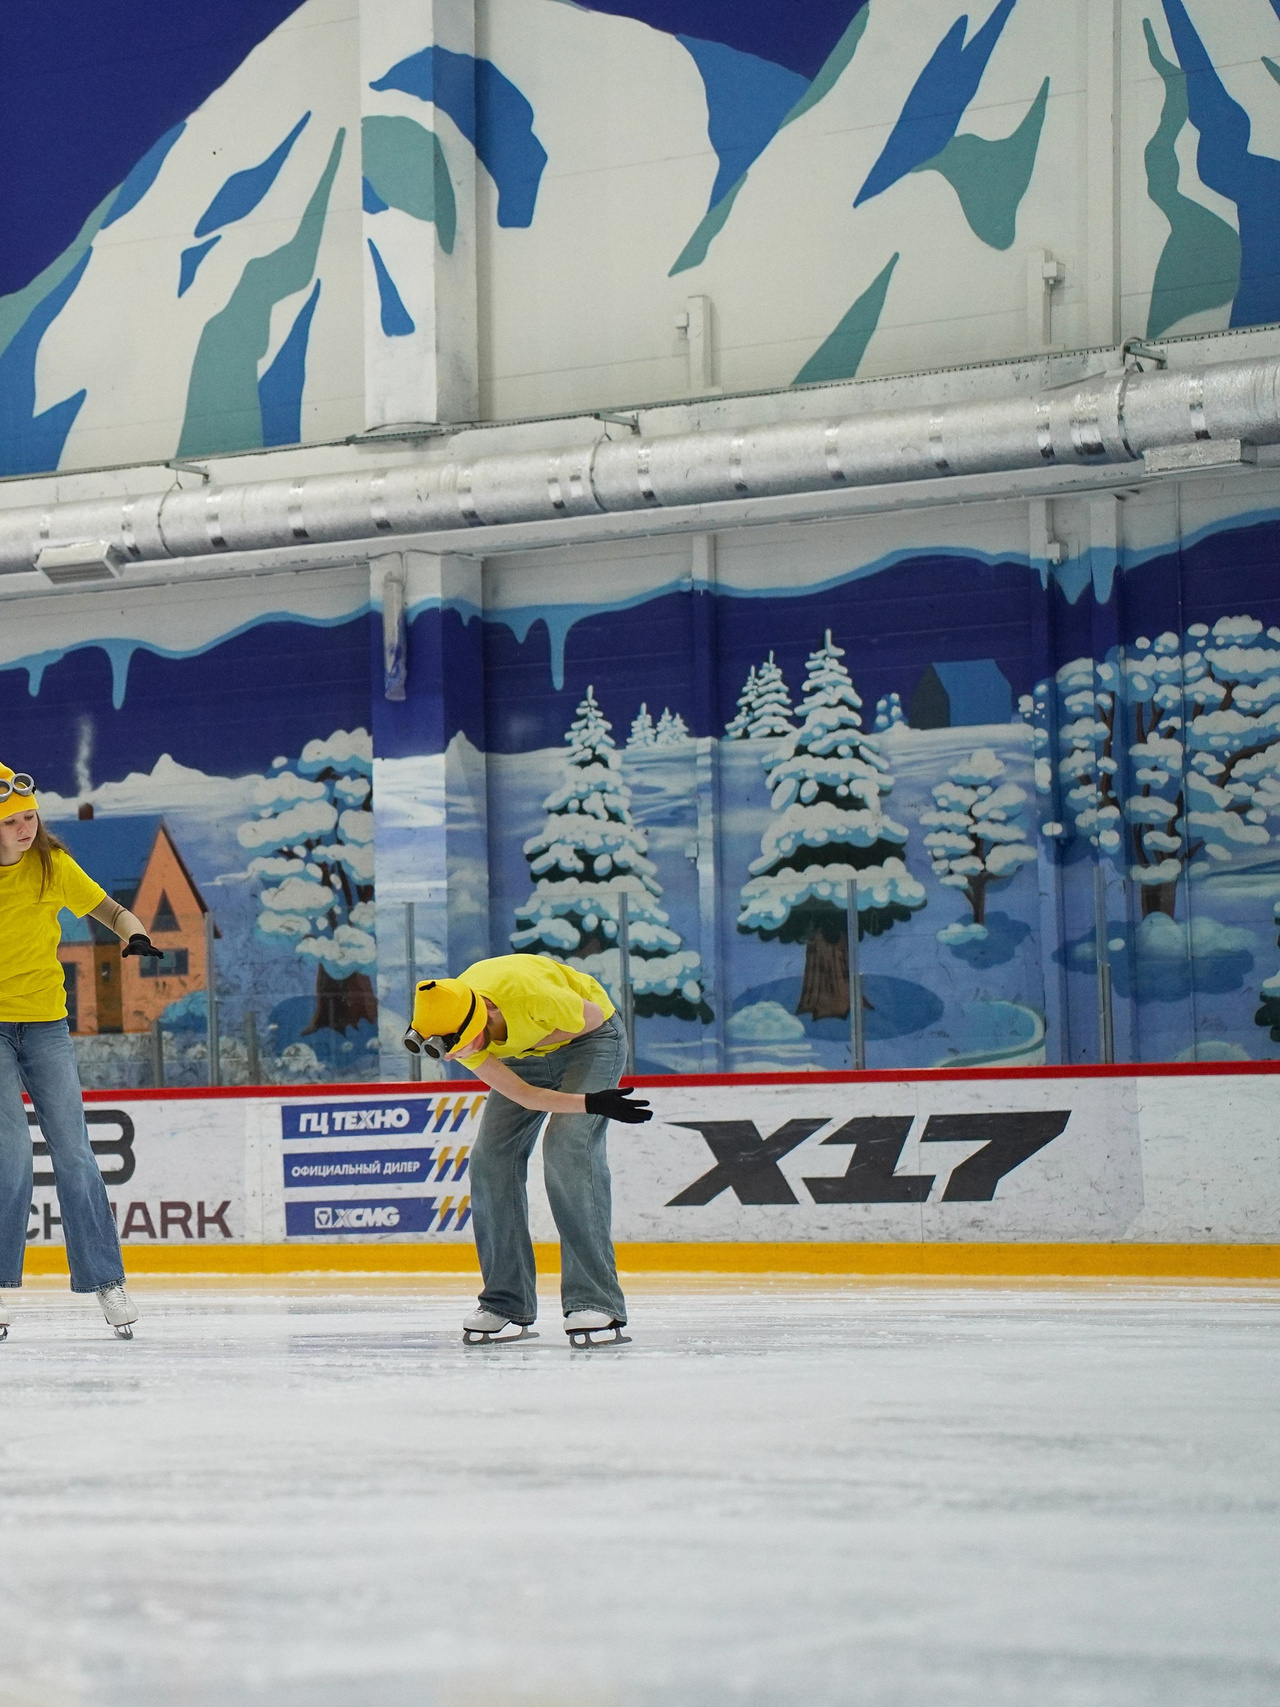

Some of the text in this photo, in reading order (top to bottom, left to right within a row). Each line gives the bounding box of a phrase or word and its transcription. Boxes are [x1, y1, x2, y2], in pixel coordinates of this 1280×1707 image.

[332, 1107, 410, 1131] ТЕХНО
[291, 1160, 420, 1178] ОФИЦИАЛЬНЫЙ ДИЛЕР
[664, 1110, 1072, 1206] X17
[332, 1206, 400, 1228] XCMG
